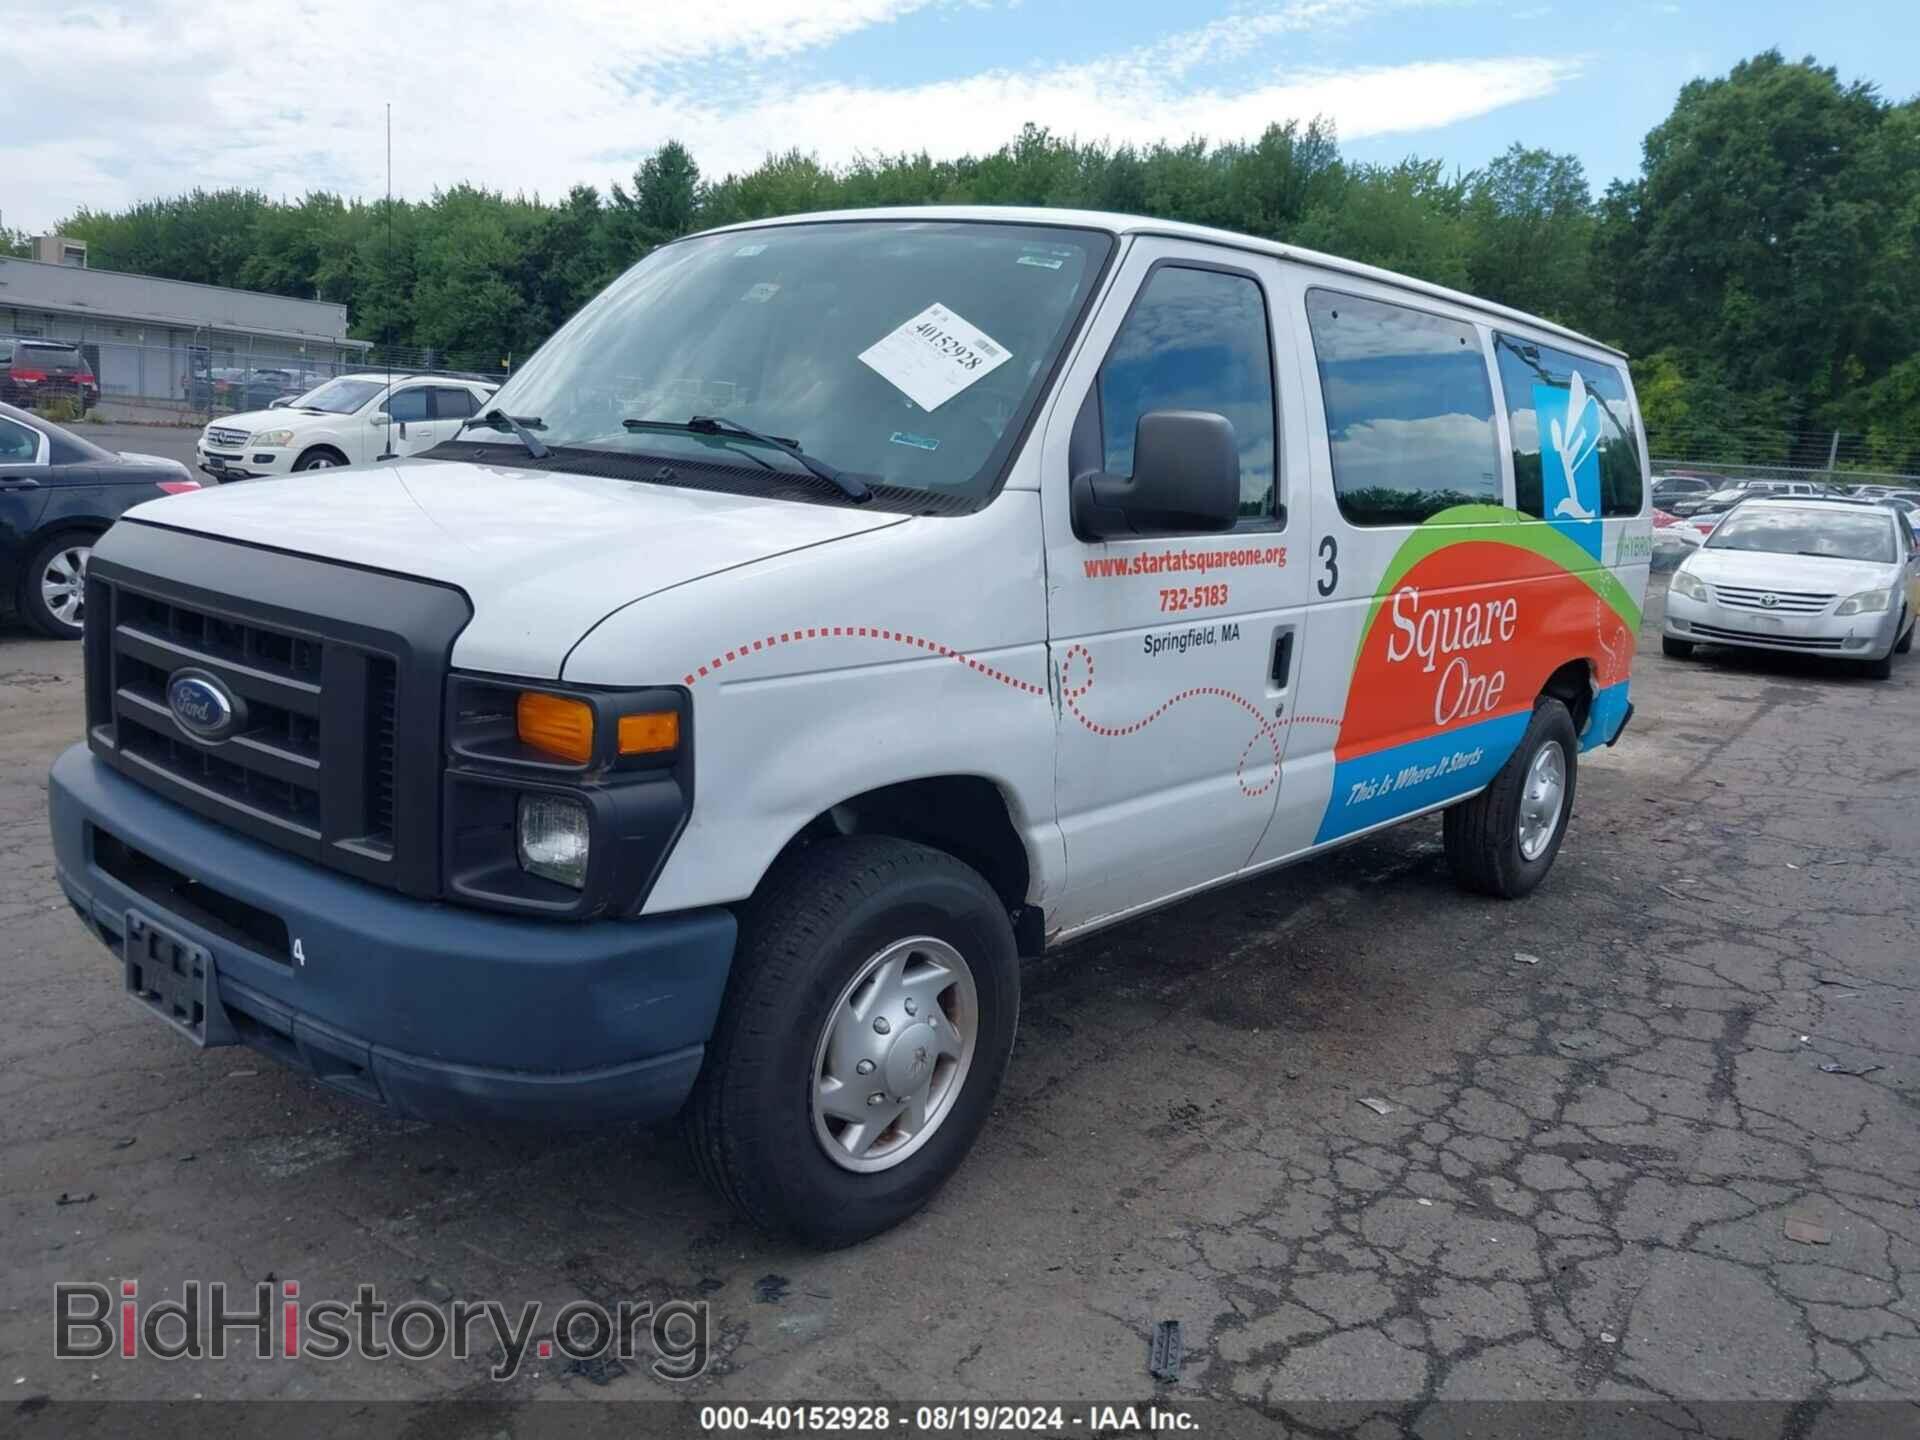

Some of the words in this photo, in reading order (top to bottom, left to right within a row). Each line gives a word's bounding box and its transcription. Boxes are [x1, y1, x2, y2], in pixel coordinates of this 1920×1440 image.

[915, 322, 983, 370] 40152928
[1084, 547, 1288, 578] www.startatsquareone.org
[1317, 535, 1339, 597] 3
[1159, 584, 1229, 612] 732-5183
[1143, 630, 1217, 657] Springfield,
[1221, 623, 1241, 642] MA
[1387, 586, 1518, 673] Square
[176, 687, 210, 721] Ford
[1434, 656, 1505, 726] One
[1346, 778, 1379, 806] This
[1377, 774, 1394, 796] Is
[1393, 765, 1437, 791] Where
[1433, 756, 1451, 778] It
[1446, 746, 1484, 774] Starts
[293, 938, 305, 967] 4
